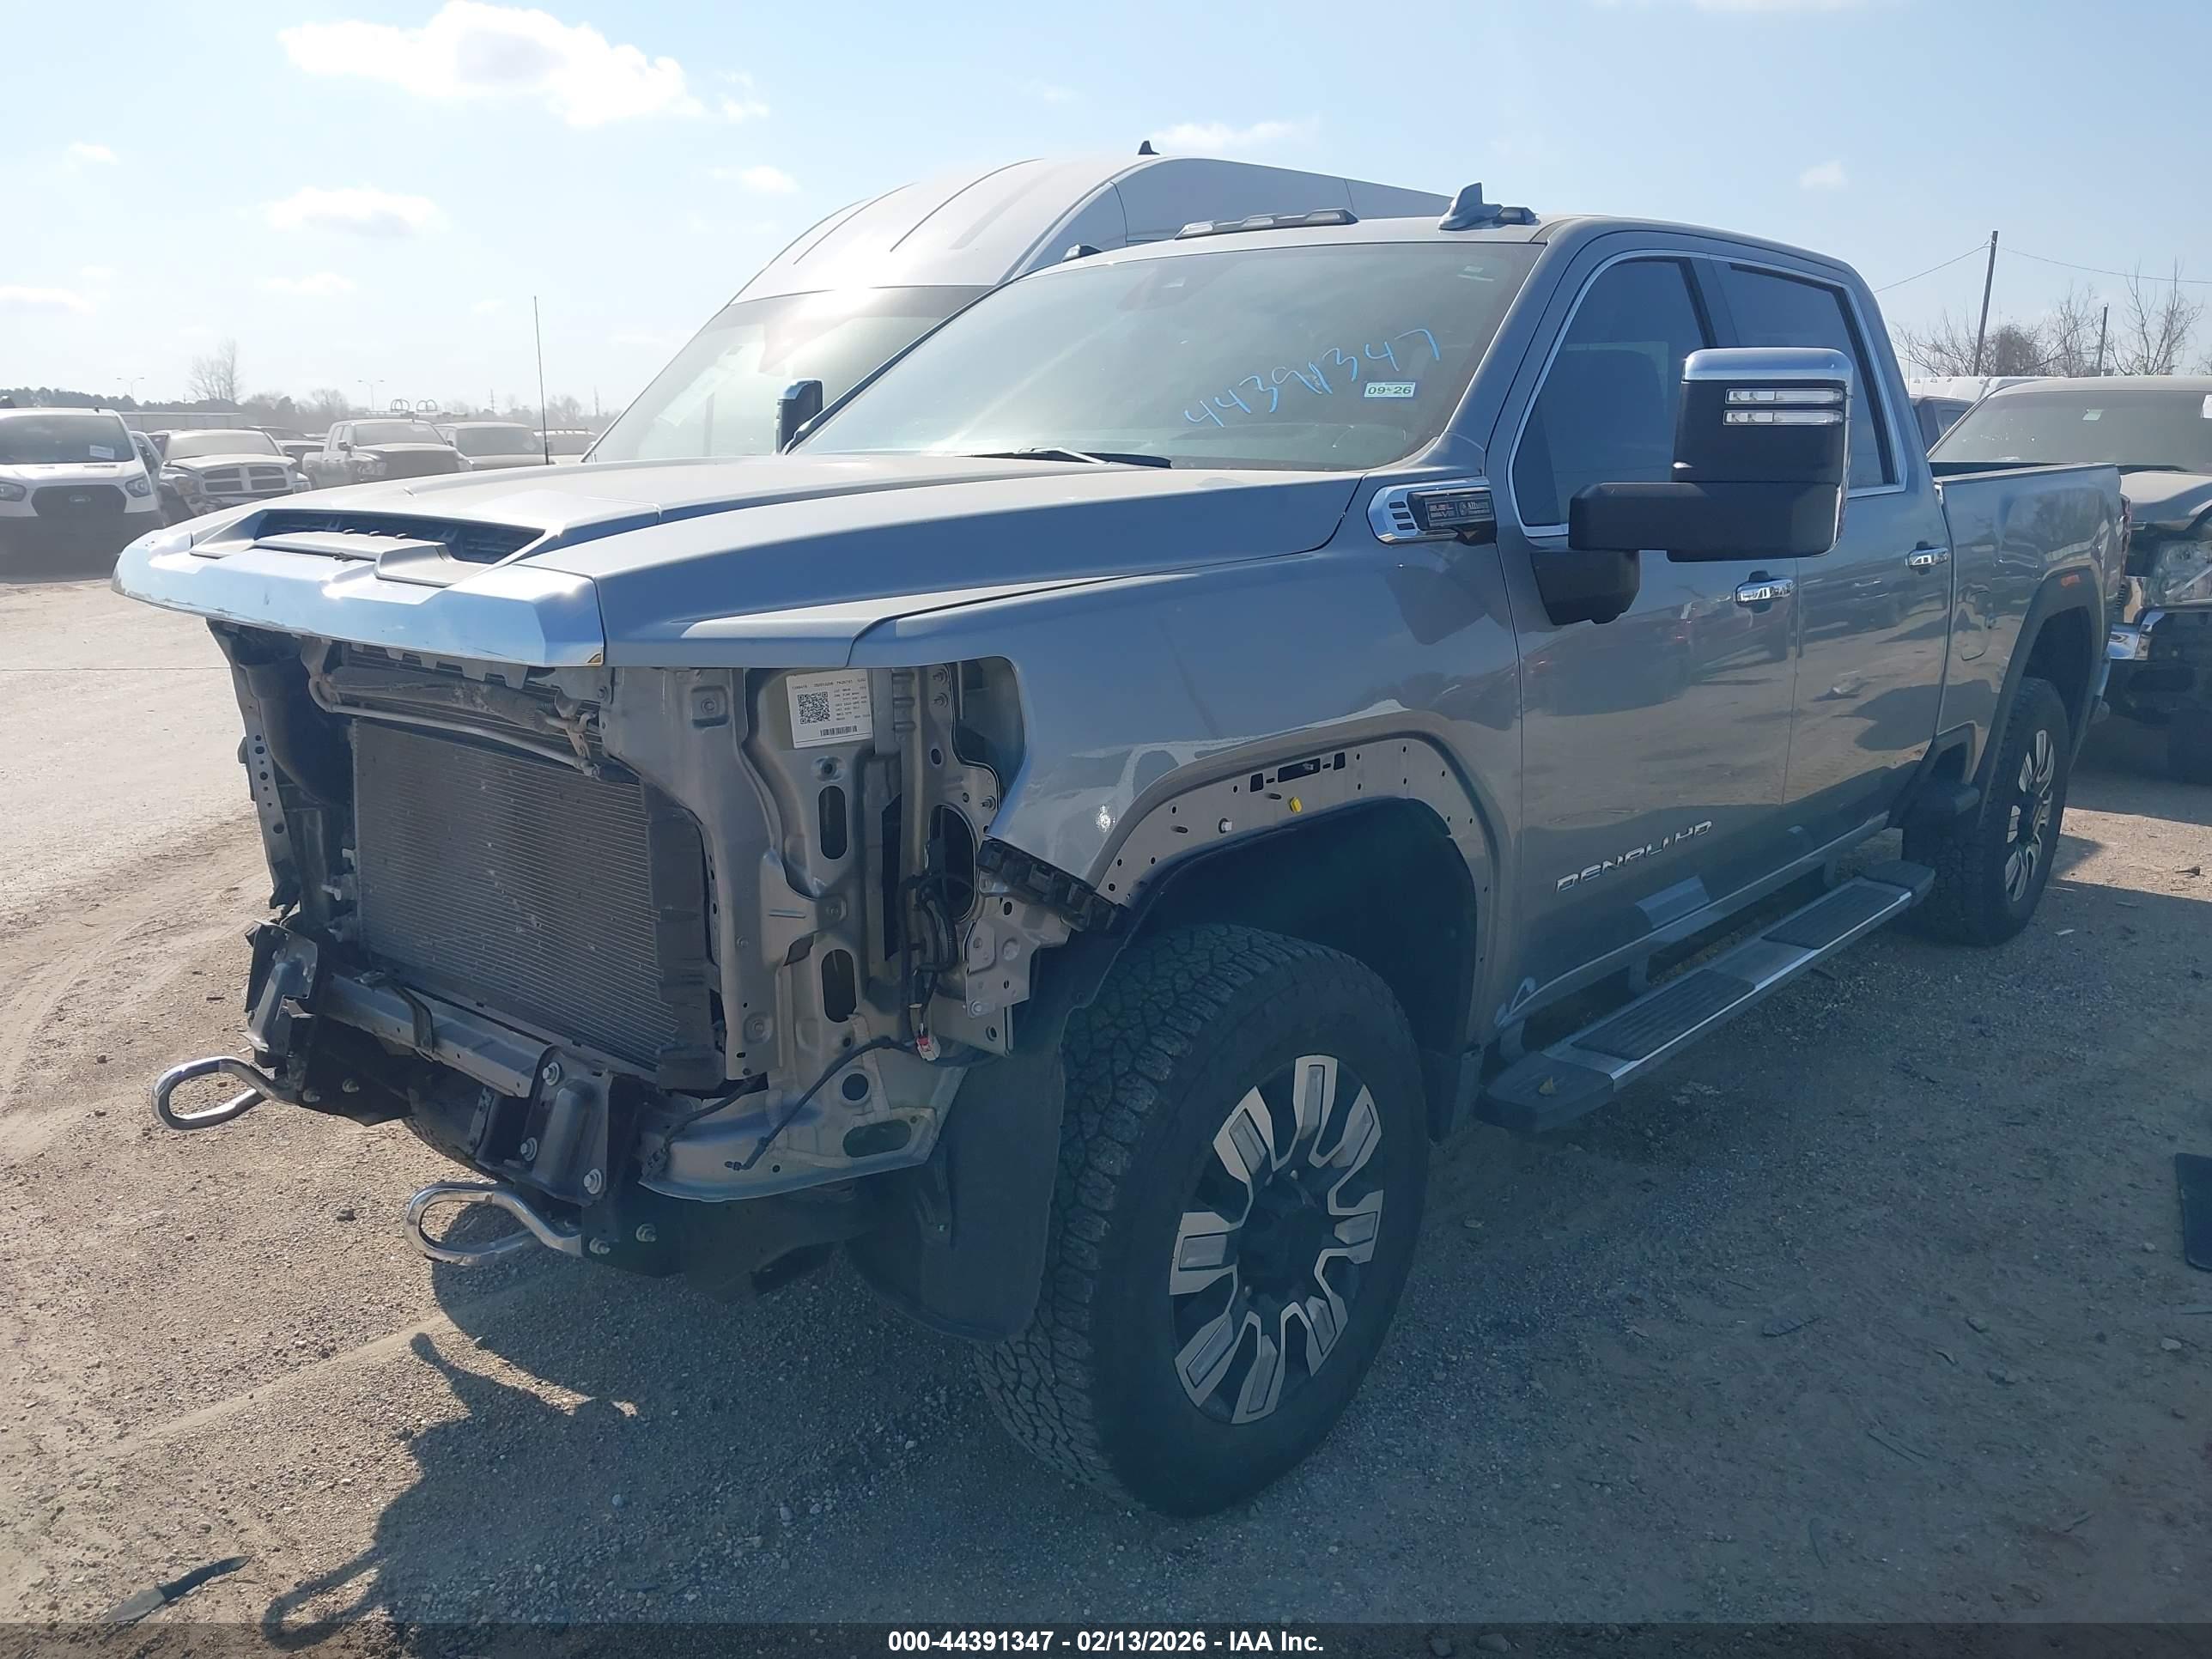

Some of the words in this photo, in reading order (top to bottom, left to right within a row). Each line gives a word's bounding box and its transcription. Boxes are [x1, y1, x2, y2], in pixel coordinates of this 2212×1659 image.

[1183, 328, 1441, 428] 44391347
[1555, 836, 1669, 893] DENALI
[1674, 820, 1713, 843] HD
